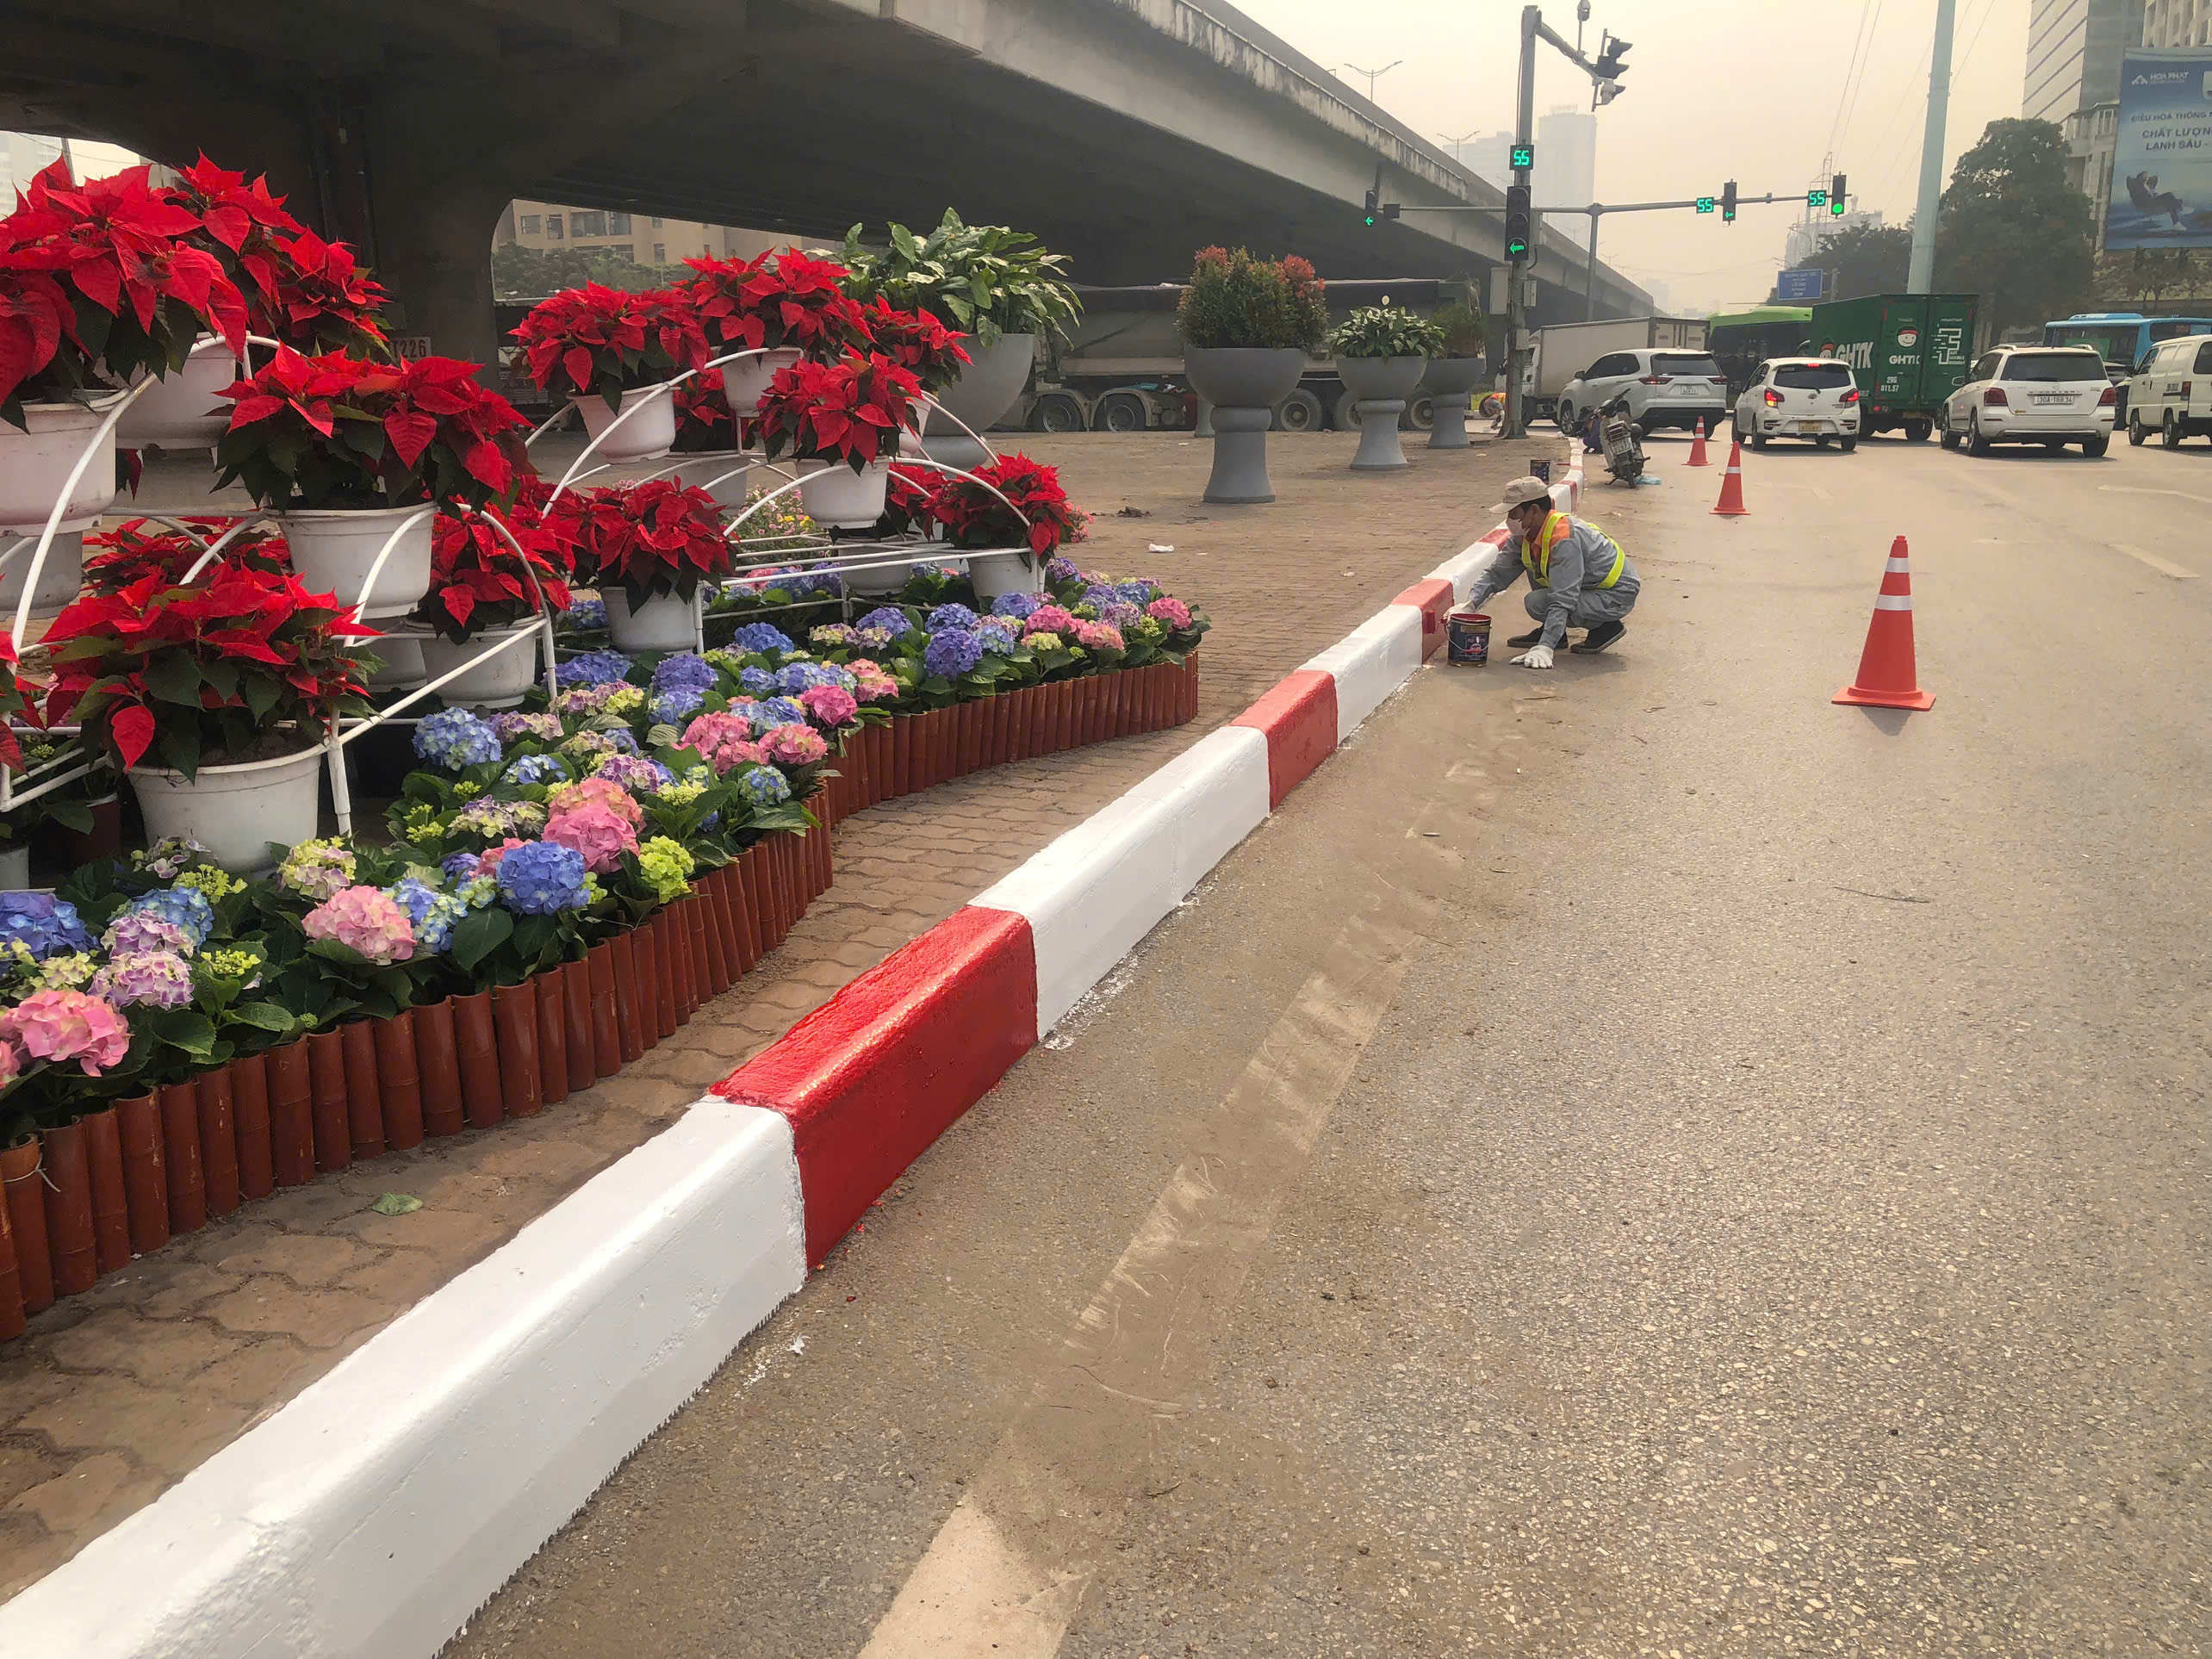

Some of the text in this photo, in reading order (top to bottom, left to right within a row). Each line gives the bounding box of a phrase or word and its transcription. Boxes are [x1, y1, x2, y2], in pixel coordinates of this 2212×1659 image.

[2175, 127, 2212, 138] LƯỢN
[1513, 150, 1530, 166] 55
[1697, 198, 1713, 213] 55
[1809, 191, 1825, 206] 55
[1836, 341, 1873, 370] GHTK
[1889, 355, 1921, 365] GHTK
